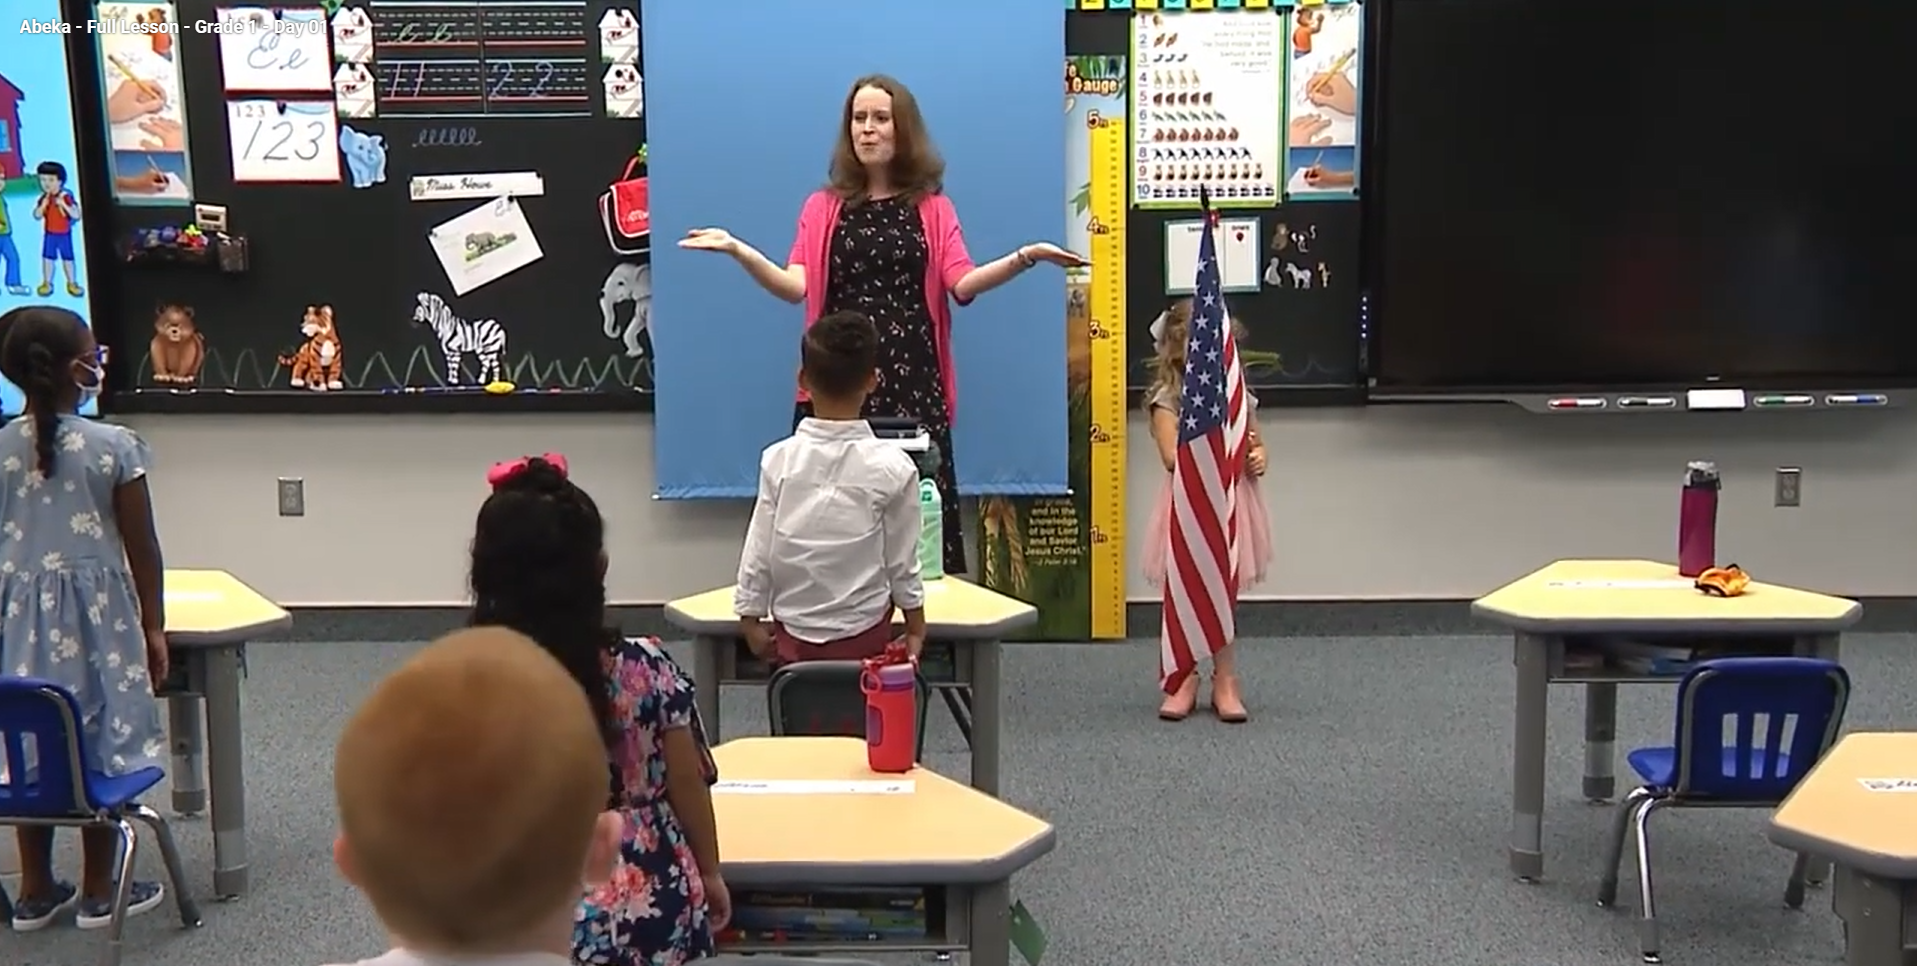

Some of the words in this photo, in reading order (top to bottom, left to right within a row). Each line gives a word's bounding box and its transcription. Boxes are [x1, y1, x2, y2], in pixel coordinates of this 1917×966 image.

[1140, 14, 1146, 25] 1
[1139, 33, 1147, 44] 2
[1139, 52, 1147, 63] 3
[1139, 72, 1147, 82] 4
[1072, 77, 1118, 95] Gauge
[1140, 90, 1147, 102] 5
[1139, 109, 1147, 121] 6
[1139, 128, 1147, 139] 7
[1138, 146, 1147, 158] 8
[1138, 165, 1147, 177] 9
[426, 178, 455, 191] Miss
[1137, 183, 1150, 195] 10
[1032, 508, 1048, 516] and
[1050, 507, 1059, 515] in
[1061, 507, 1076, 515] the
[1029, 517, 1078, 527] knowledge
[1029, 527, 1038, 536] of
[1058, 526, 1079, 536] Lord
[1030, 537, 1047, 545] and
[1049, 537, 1077, 545] Savior
[1024, 546, 1051, 556] Jesus
